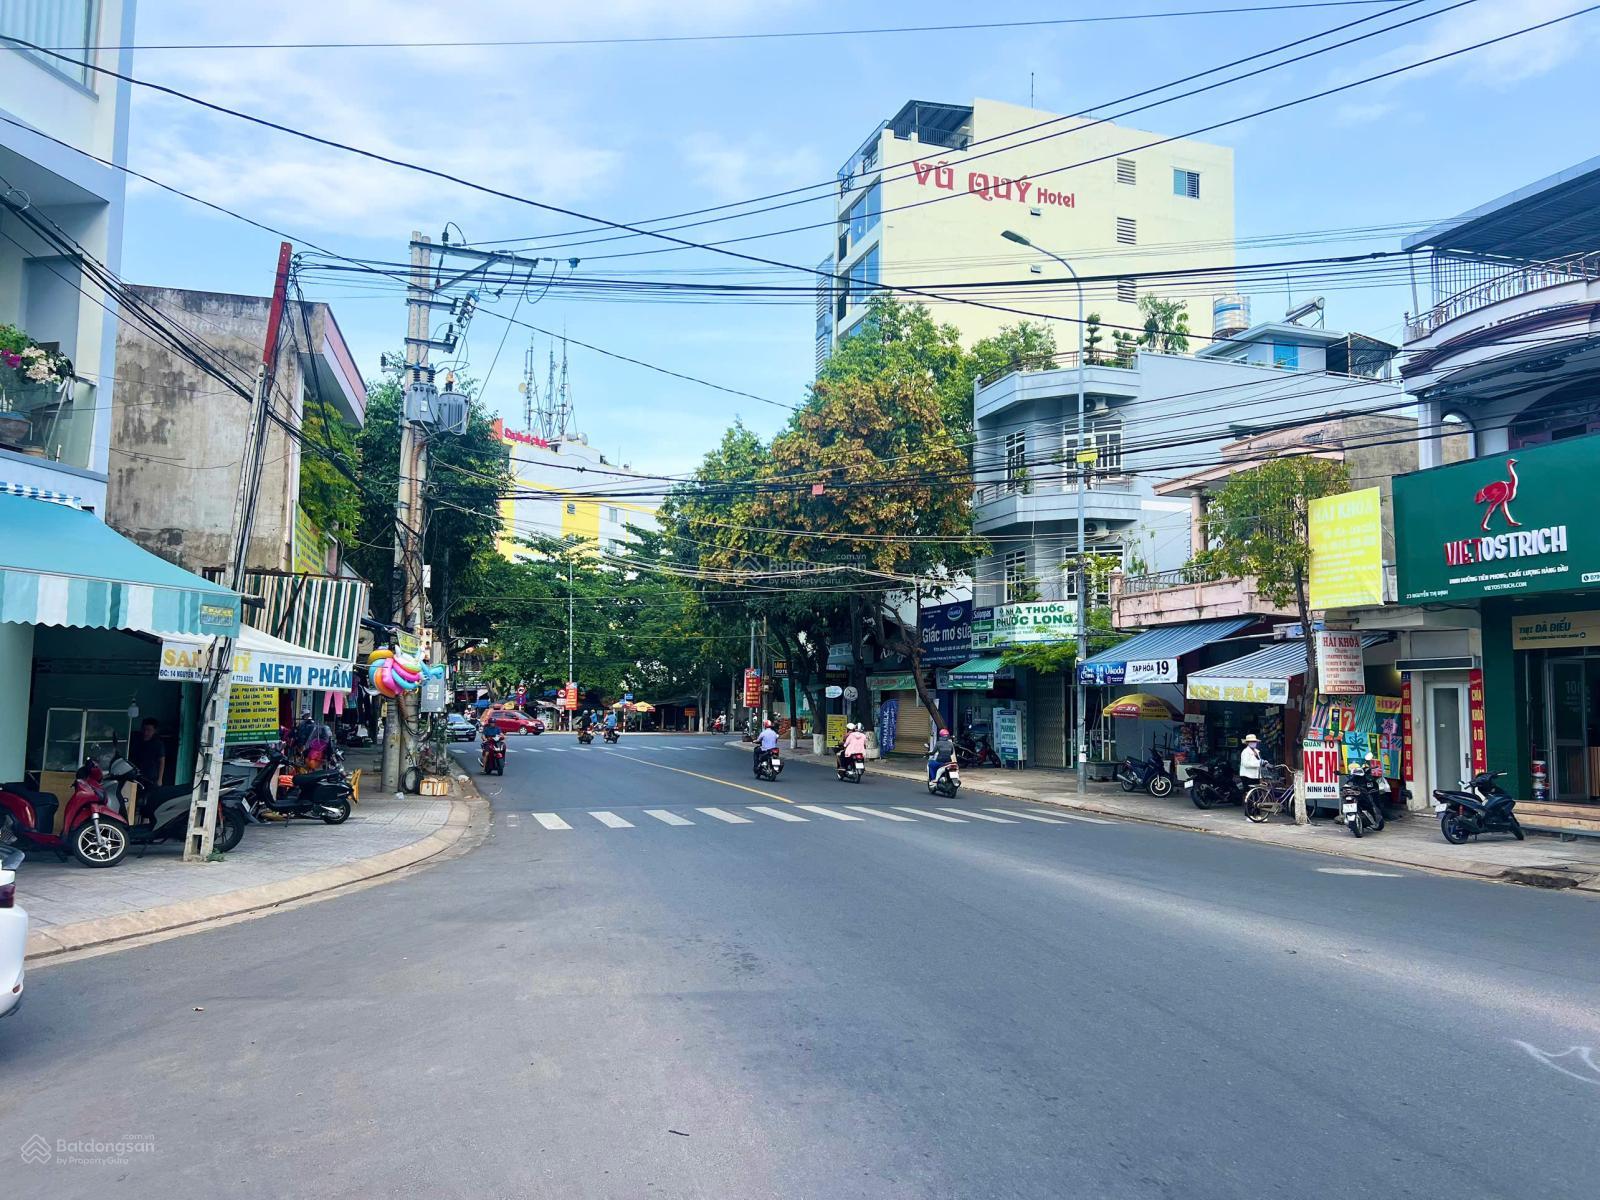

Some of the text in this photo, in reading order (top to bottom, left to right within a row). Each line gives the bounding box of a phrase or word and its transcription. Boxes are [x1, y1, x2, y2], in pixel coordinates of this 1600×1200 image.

[913, 160, 1075, 208] VŨ QUÝ Hotel
[1444, 525, 1568, 566] VIETOSTRICH
[1005, 602, 1065, 615] NHÀ THUỐC
[996, 614, 1074, 627] PHƯỚC LONG
[1535, 620, 1548, 633] ĐÀ
[922, 623, 941, 643] Giấc
[942, 626, 956, 641] mơ
[1323, 633, 1337, 647] HẢI
[176, 669, 194, 678] NGUYỄN
[259, 662, 303, 684] NEM
[1132, 664, 1142, 675] TẠP
[1155, 660, 1169, 675] 19
[1303, 751, 1338, 783] NEM
[1307, 785, 1322, 793] NINH
